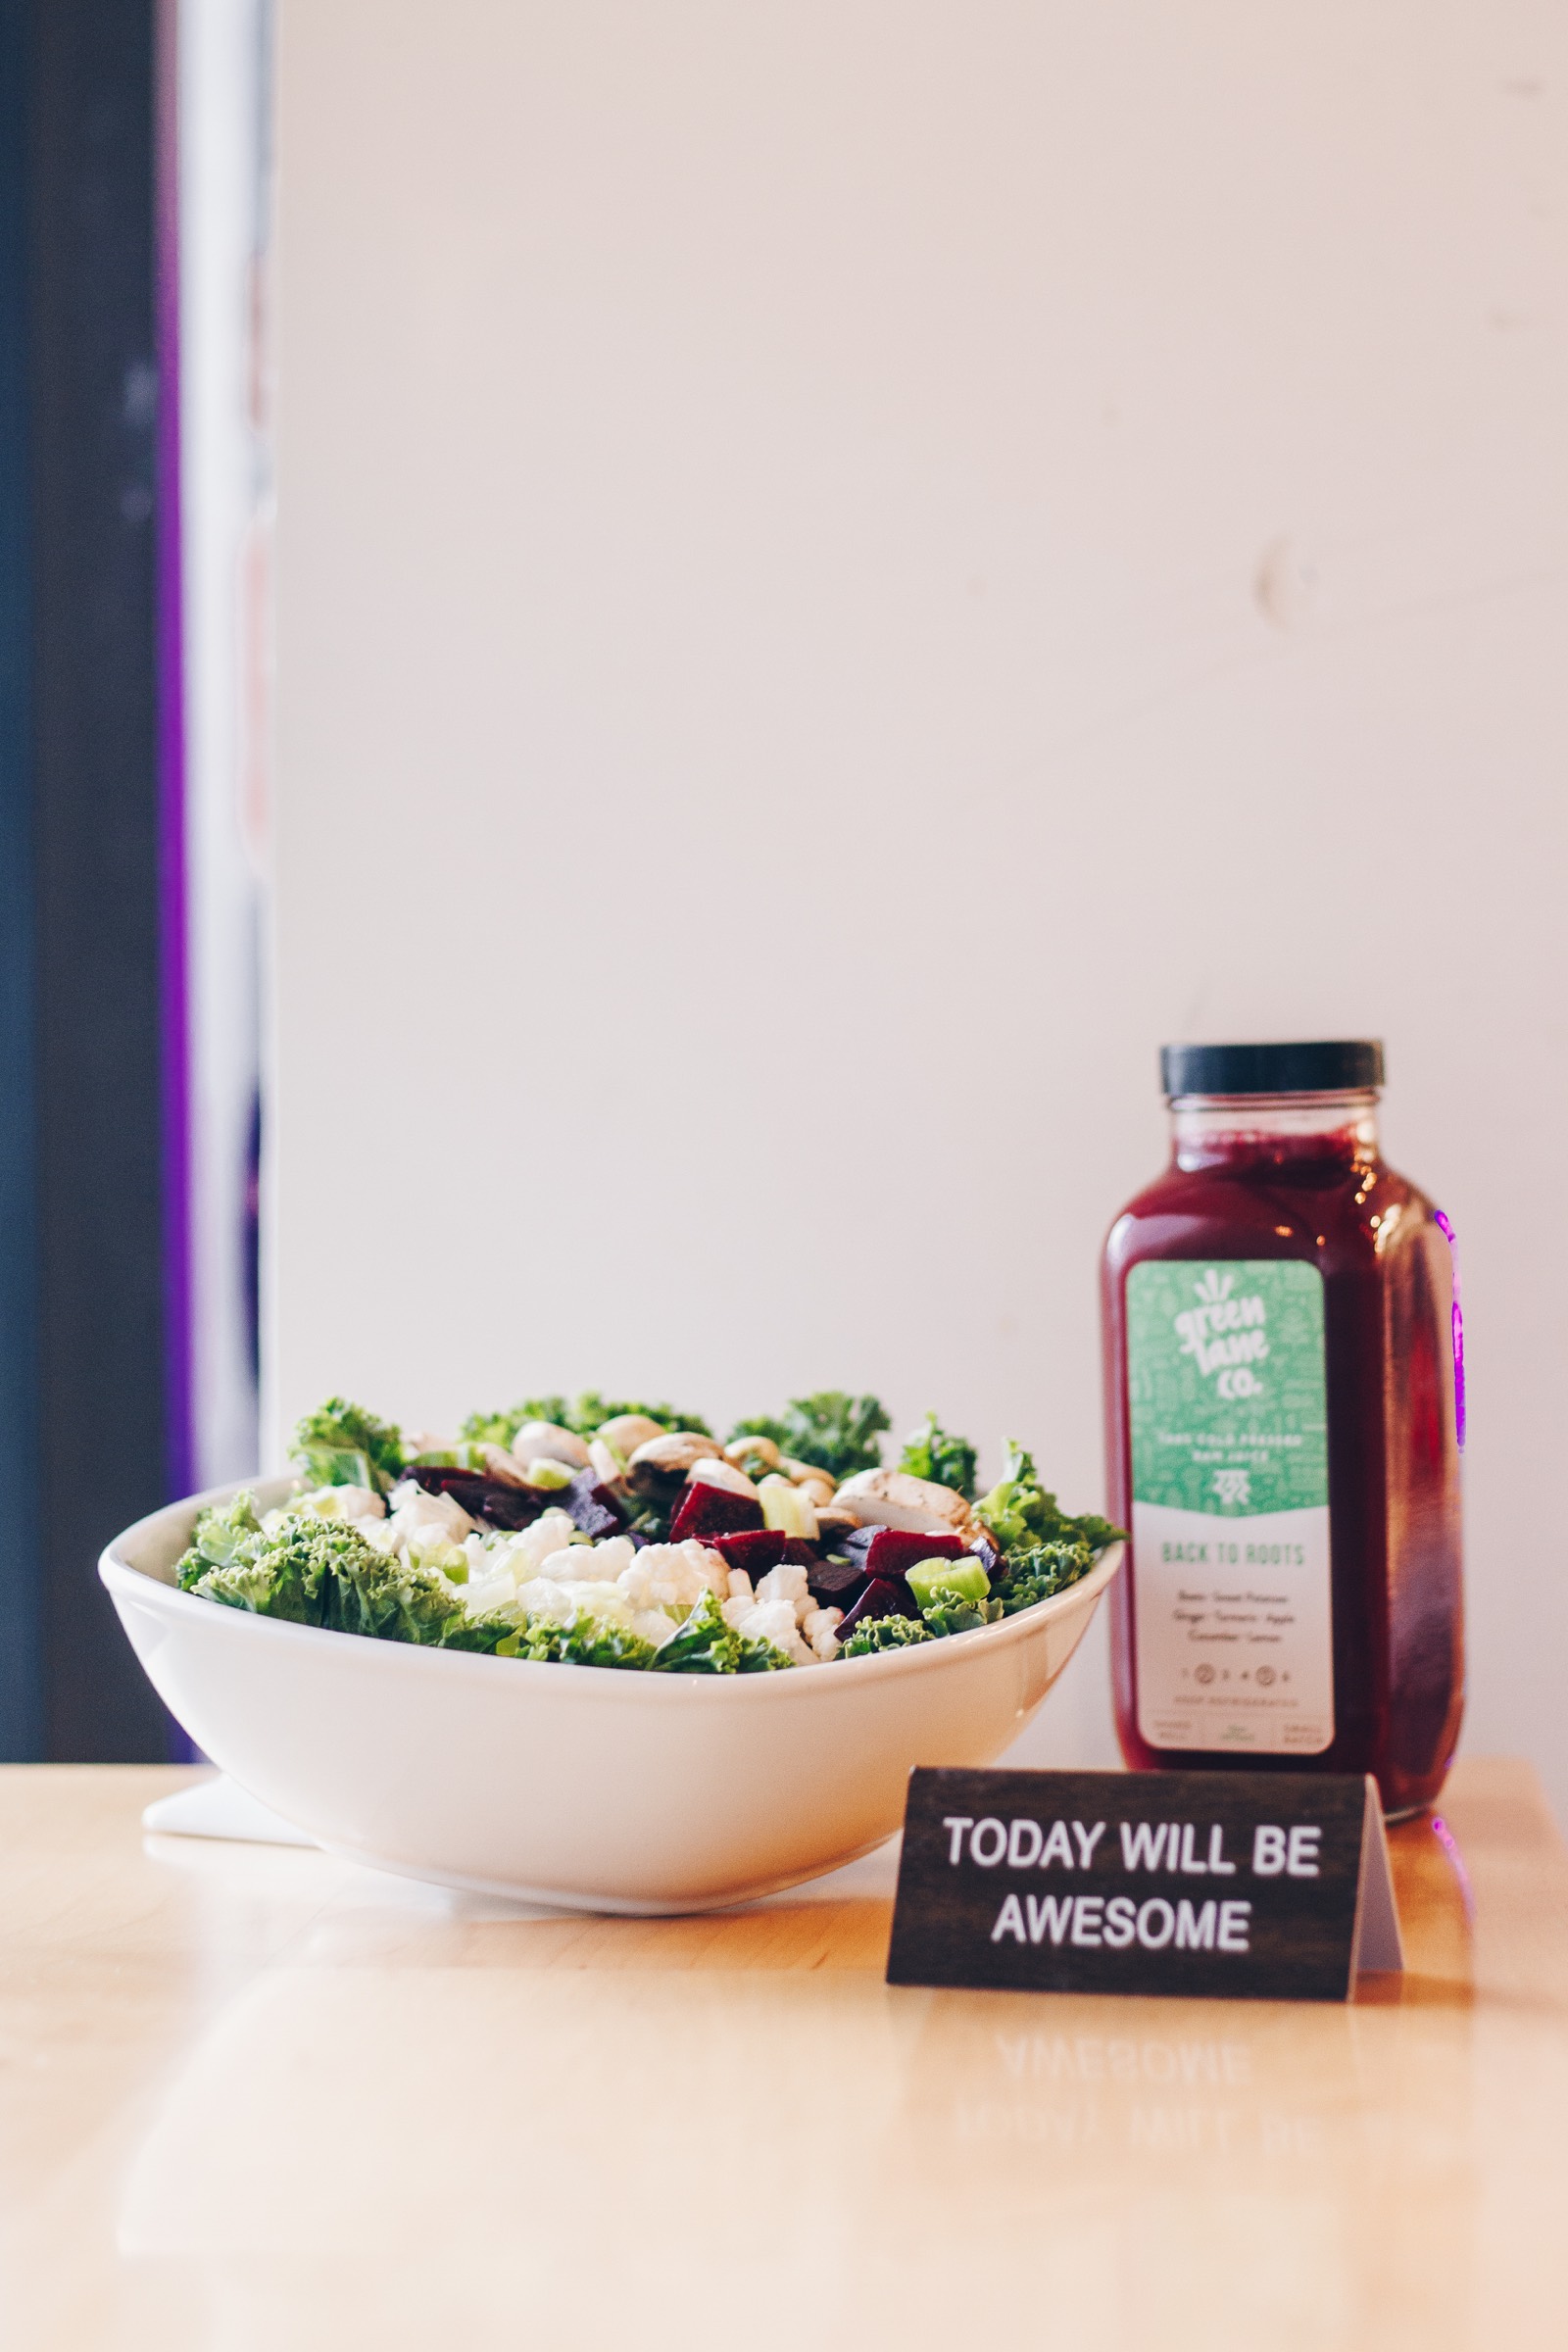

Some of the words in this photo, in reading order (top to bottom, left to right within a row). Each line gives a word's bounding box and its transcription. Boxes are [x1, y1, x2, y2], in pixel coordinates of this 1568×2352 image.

[1175, 1296, 1266, 1354] green
[1195, 1329, 1270, 1377] lane
[1162, 1542, 1208, 1562] BACK
[1217, 1542, 1240, 1563] TO
[1247, 1543, 1304, 1565] ROOTS
[942, 1816, 1107, 1870] TODAY
[1120, 1820, 1237, 1876] WILL
[1252, 1824, 1322, 1878] BE
[990, 1892, 1253, 1952] AWESOME
